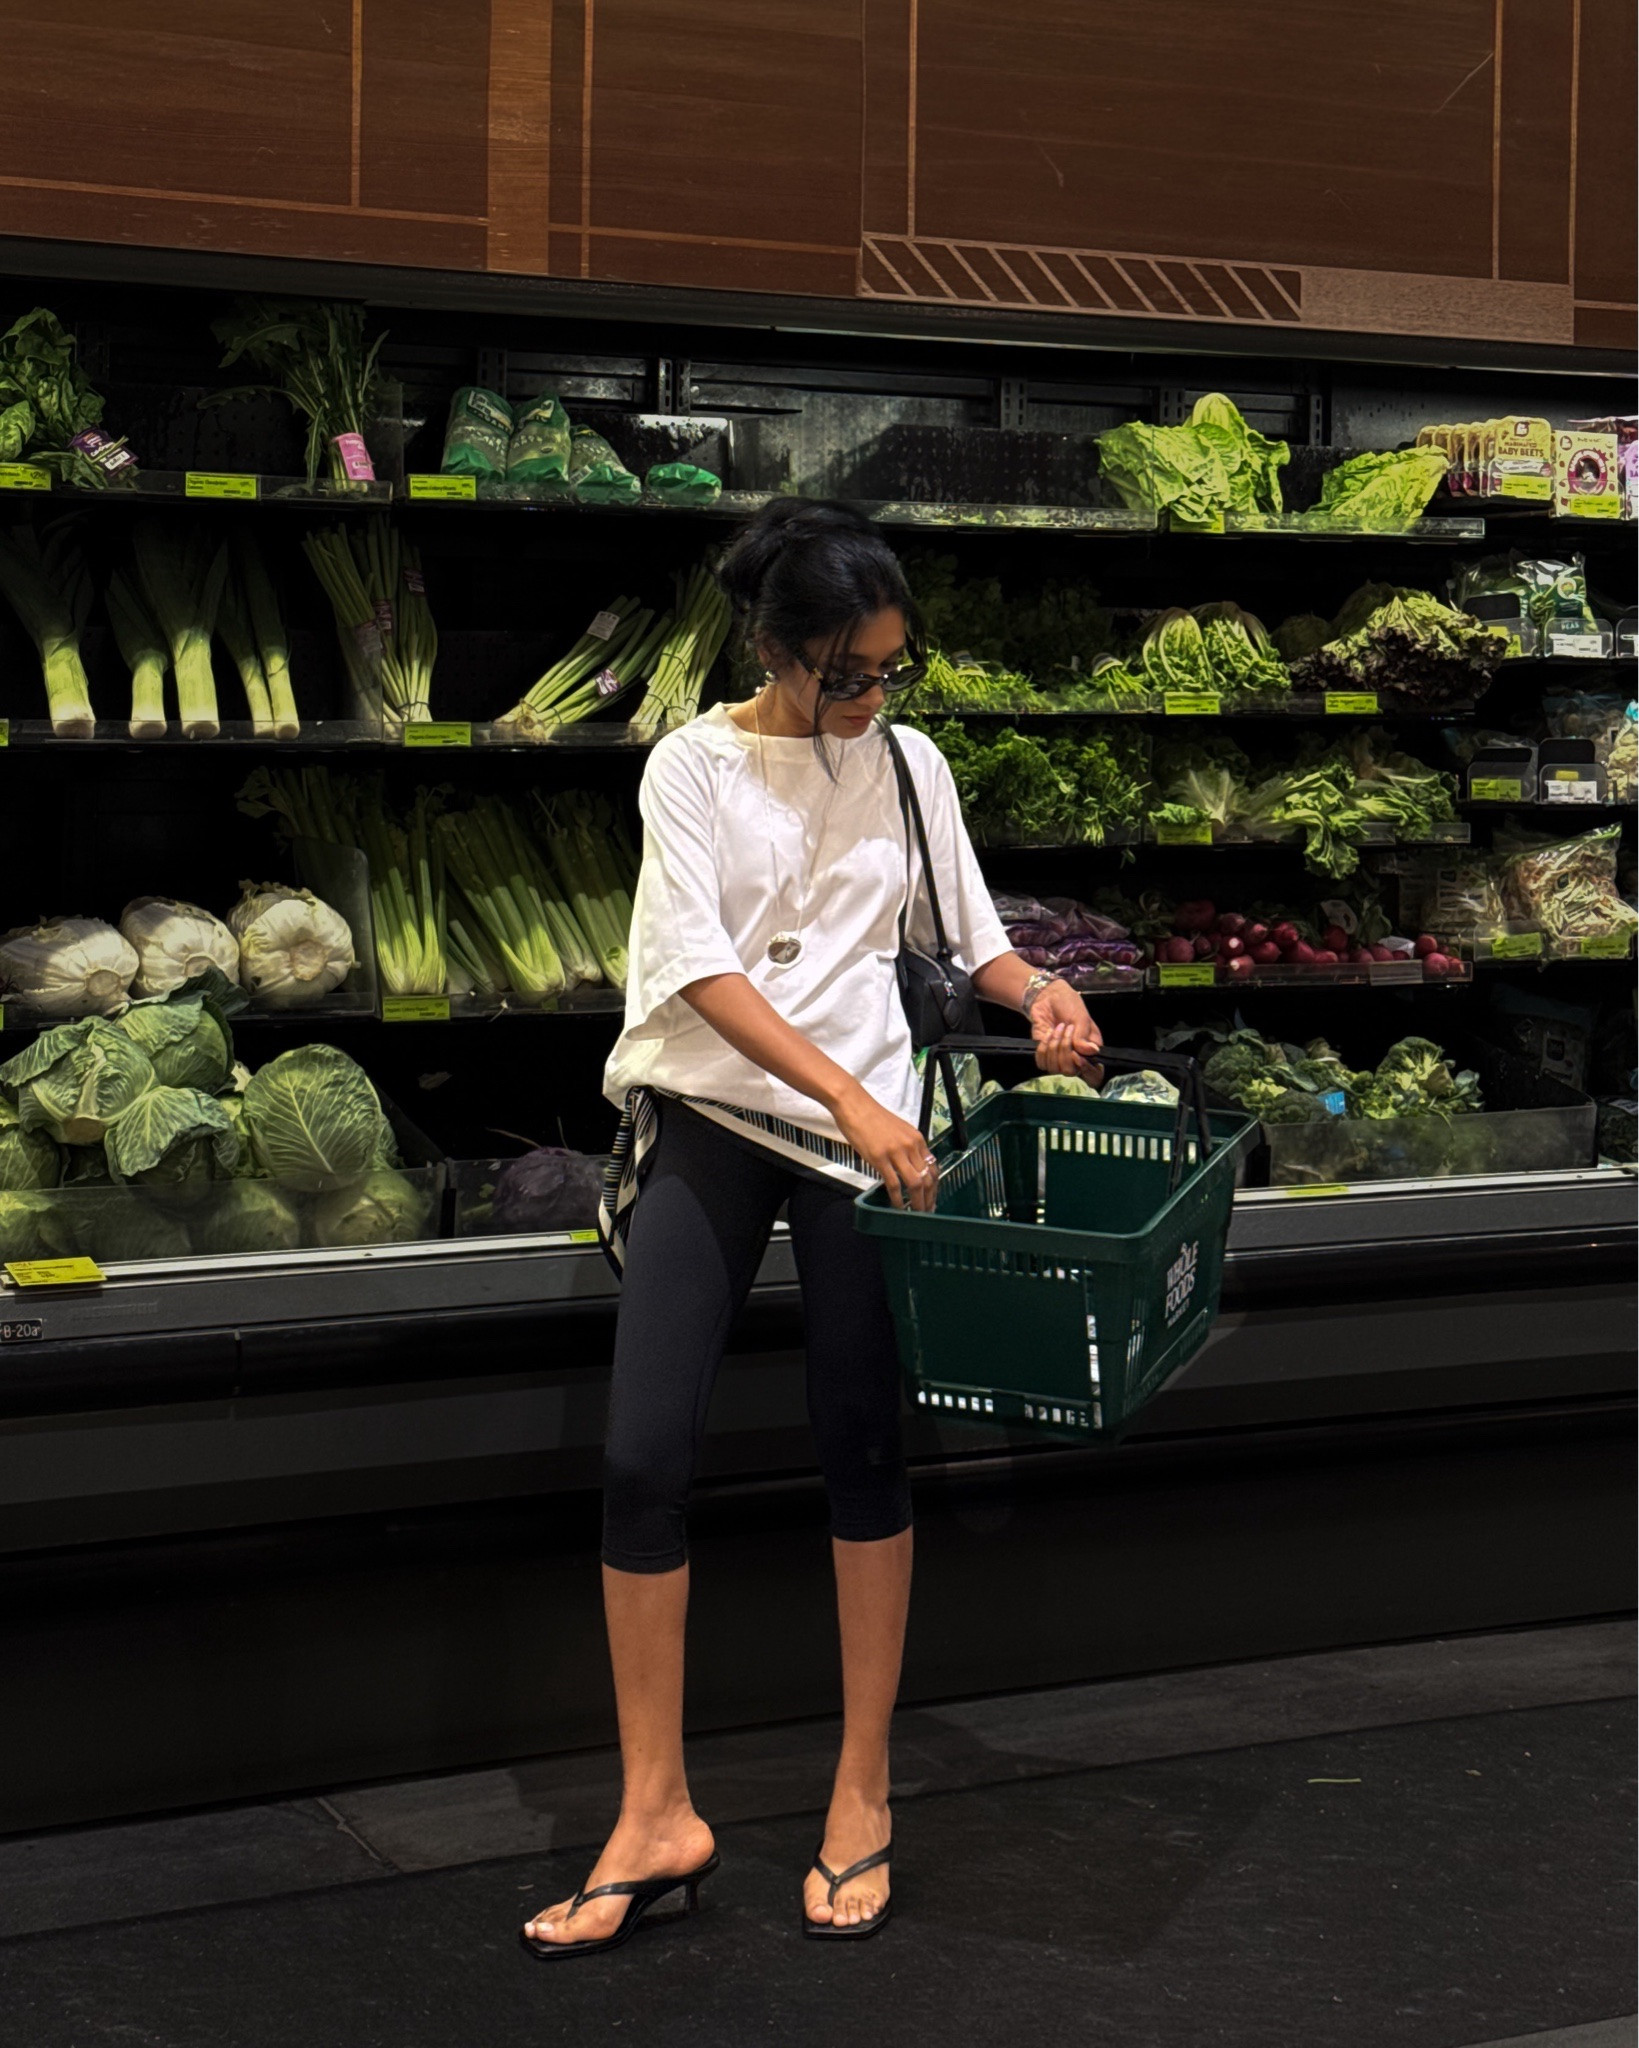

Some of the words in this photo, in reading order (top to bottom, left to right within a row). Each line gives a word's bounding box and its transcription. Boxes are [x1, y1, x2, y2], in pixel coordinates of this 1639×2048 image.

[1498, 446, 1518, 456] BABY
[1520, 447, 1544, 457] BEETS
[1167, 1241, 1199, 1290] WHOLE
[1164, 1266, 1197, 1319] FOODS
